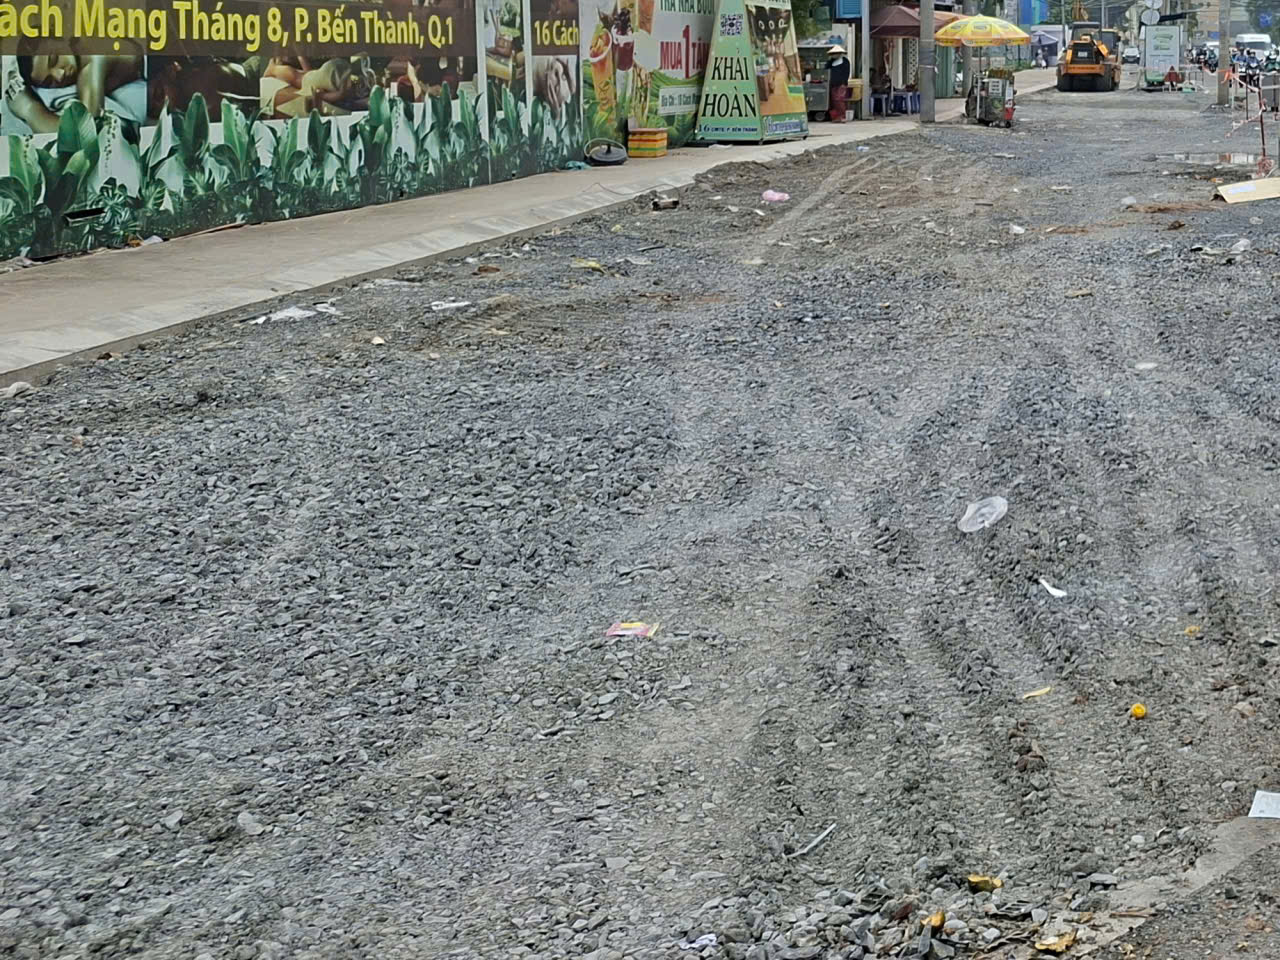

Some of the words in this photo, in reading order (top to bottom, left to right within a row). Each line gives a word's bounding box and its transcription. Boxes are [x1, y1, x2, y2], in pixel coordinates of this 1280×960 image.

[172, 0, 260, 51] Tháng
[267, 7, 289, 48] 8,
[295, 8, 312, 43] P.
[318, 4, 357, 43] Bến
[360, 10, 425, 49] Thành,
[427, 15, 453, 48] Q.1
[534, 20, 550, 45] 16
[552, 20, 580, 46] Cách
[660, 41, 683, 70] MUA
[682, 24, 691, 79] 1
[711, 47, 749, 80] KHẢI
[701, 86, 757, 118] HOÀN
